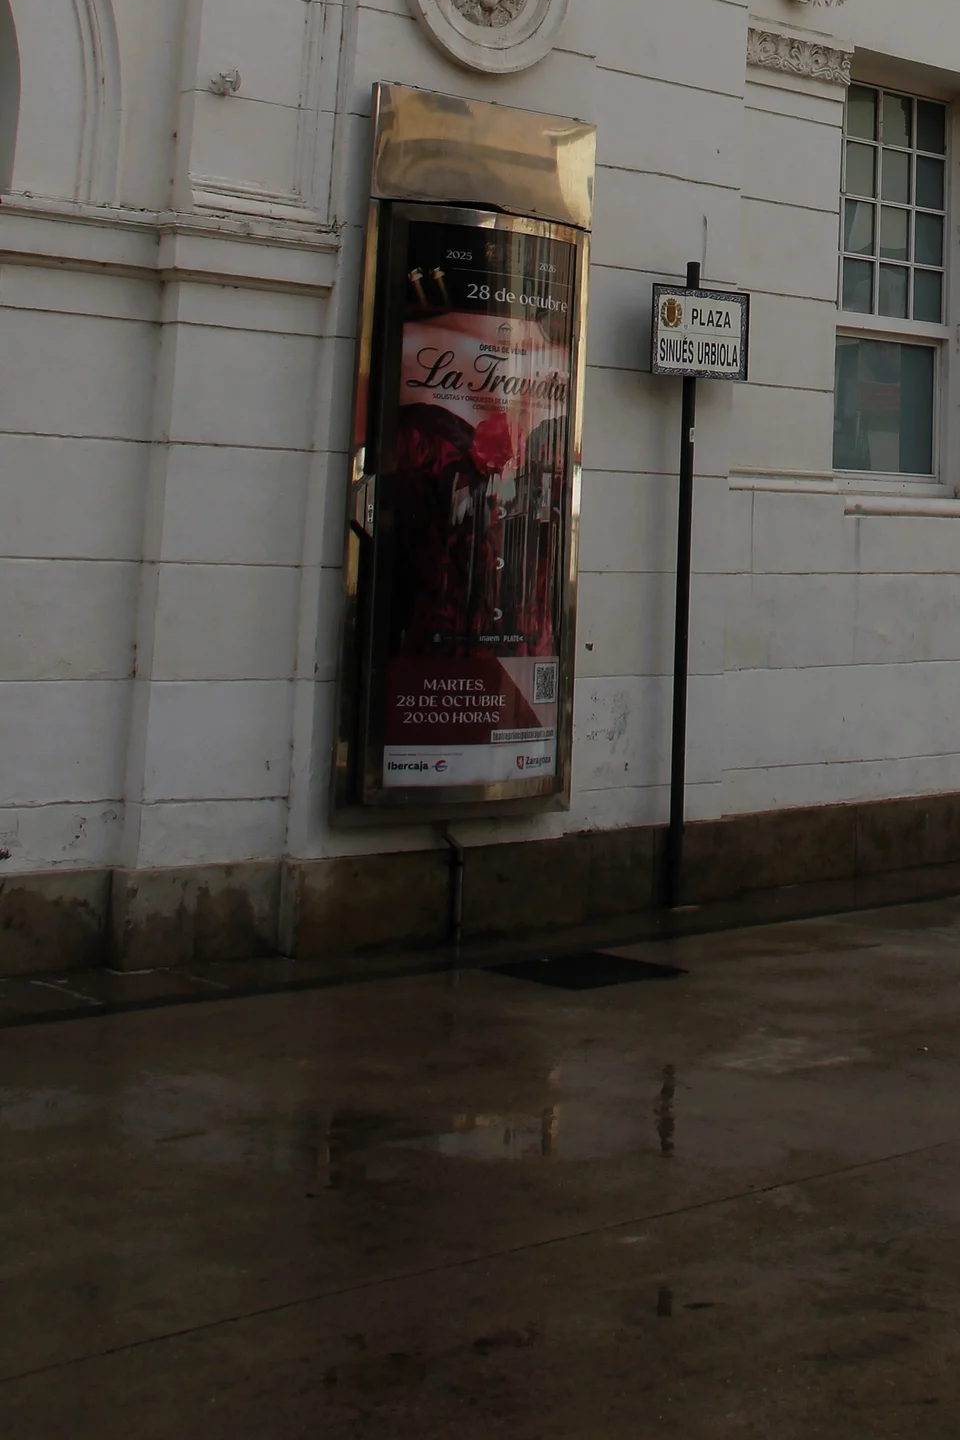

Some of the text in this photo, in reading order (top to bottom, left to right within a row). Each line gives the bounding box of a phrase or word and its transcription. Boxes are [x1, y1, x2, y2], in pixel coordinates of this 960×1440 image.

[446, 250, 556, 273] 2025 2026
[466, 283, 568, 313] 28 de octubre
[691, 308, 732, 329] PLAZA
[501, 346, 510, 354] DE
[659, 336, 738, 367] SINUÉS URBIOLA
[405, 347, 567, 404] La Traviata
[432, 392, 460, 401] SOLISTAS
[424, 678, 486, 692] MARTES,
[396, 694, 506, 707] 28 DE OCTUBRE
[403, 711, 500, 724] 20:00 HORAS
[387, 755, 552, 772] Ibercaja Zaragoza
